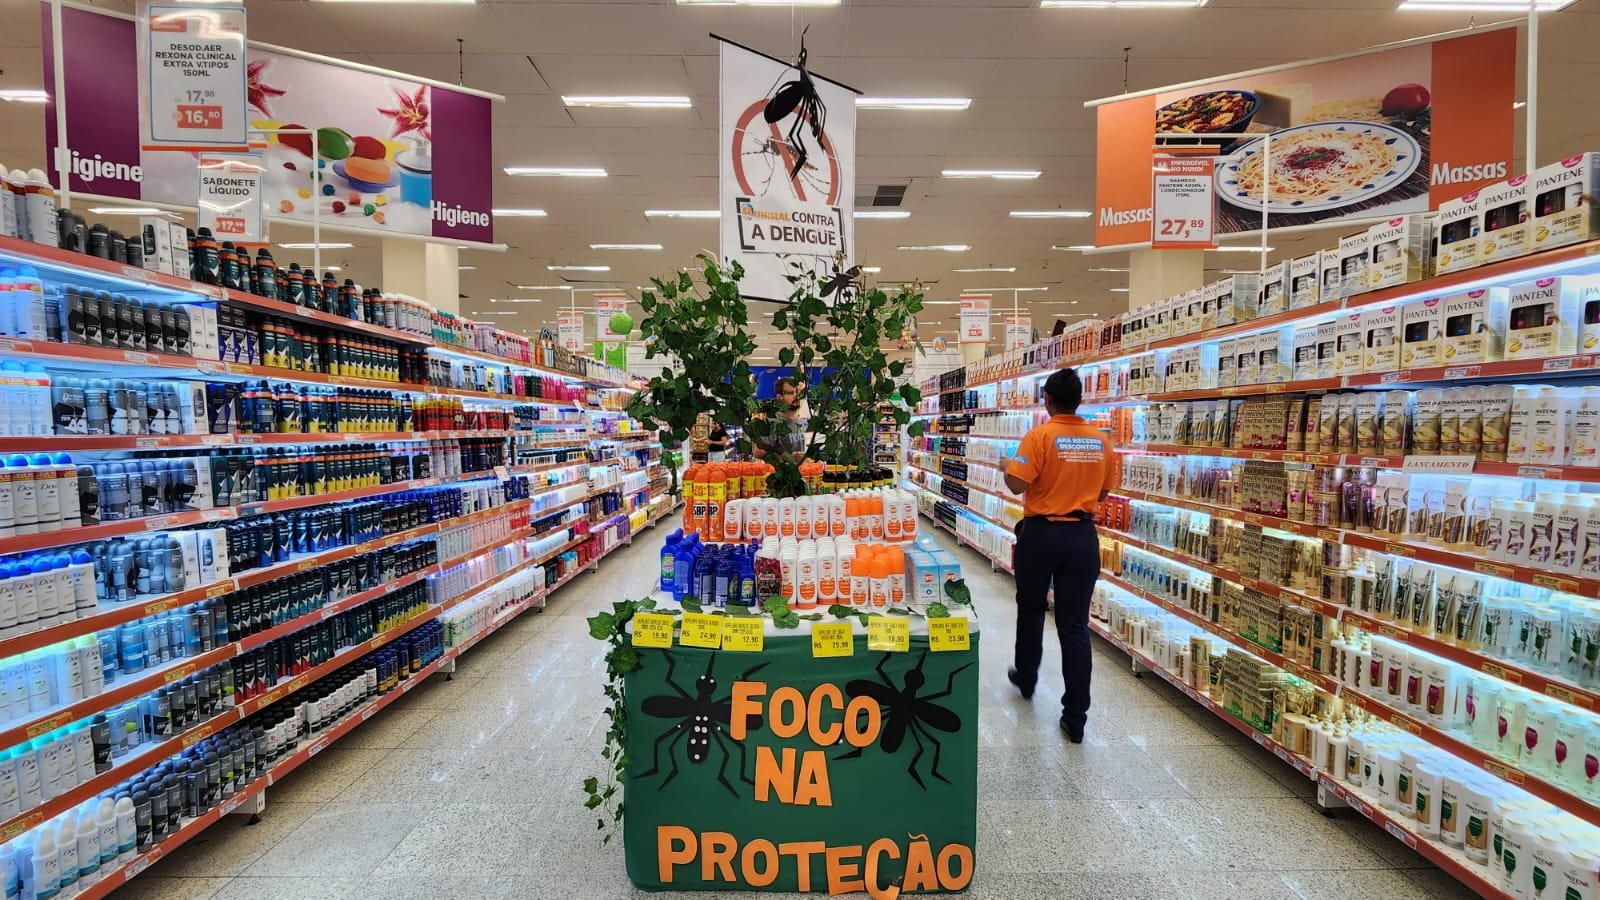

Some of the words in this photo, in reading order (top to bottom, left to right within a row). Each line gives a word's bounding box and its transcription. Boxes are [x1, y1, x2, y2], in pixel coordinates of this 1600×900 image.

[170, 43, 222, 52] DESOD.AER
[155, 52, 194, 60] REXONA
[196, 52, 236, 61] CLINICAL
[163, 60, 194, 68] EXTRA
[196, 61, 229, 69] V.TIPOS
[184, 69, 210, 77] 150ML
[1431, 161, 1507, 186] Massas
[1536, 167, 1584, 189] PANTENE
[203, 177, 256, 187] SABONETE
[209, 186, 249, 196] LÍQUIDO
[1485, 186, 1528, 205] PANTENE
[430, 199, 490, 227] Higiene
[792, 211, 835, 227] CONTRA
[1441, 203, 1478, 220] PANTENE
[752, 224, 765, 240] A
[770, 225, 837, 246] DENGUE
[1160, 219, 1204, 238] 27,89
[1373, 226, 1404, 241] PANTENE
[1342, 236, 1368, 250] PANTENE
[1512, 288, 1556, 304] PANTENE
[1447, 300, 1485, 312] PANTENE
[1368, 316, 1396, 326] PANTENE
[1406, 308, 1440, 320] PANTENE
[1338, 322, 1360, 332] PANTENE
[1260, 334, 1278, 343] PANTENE
[730, 681, 881, 747] FOCO
[754, 746, 832, 806] NA
[657, 826, 973, 900] PROTEÇÃO
